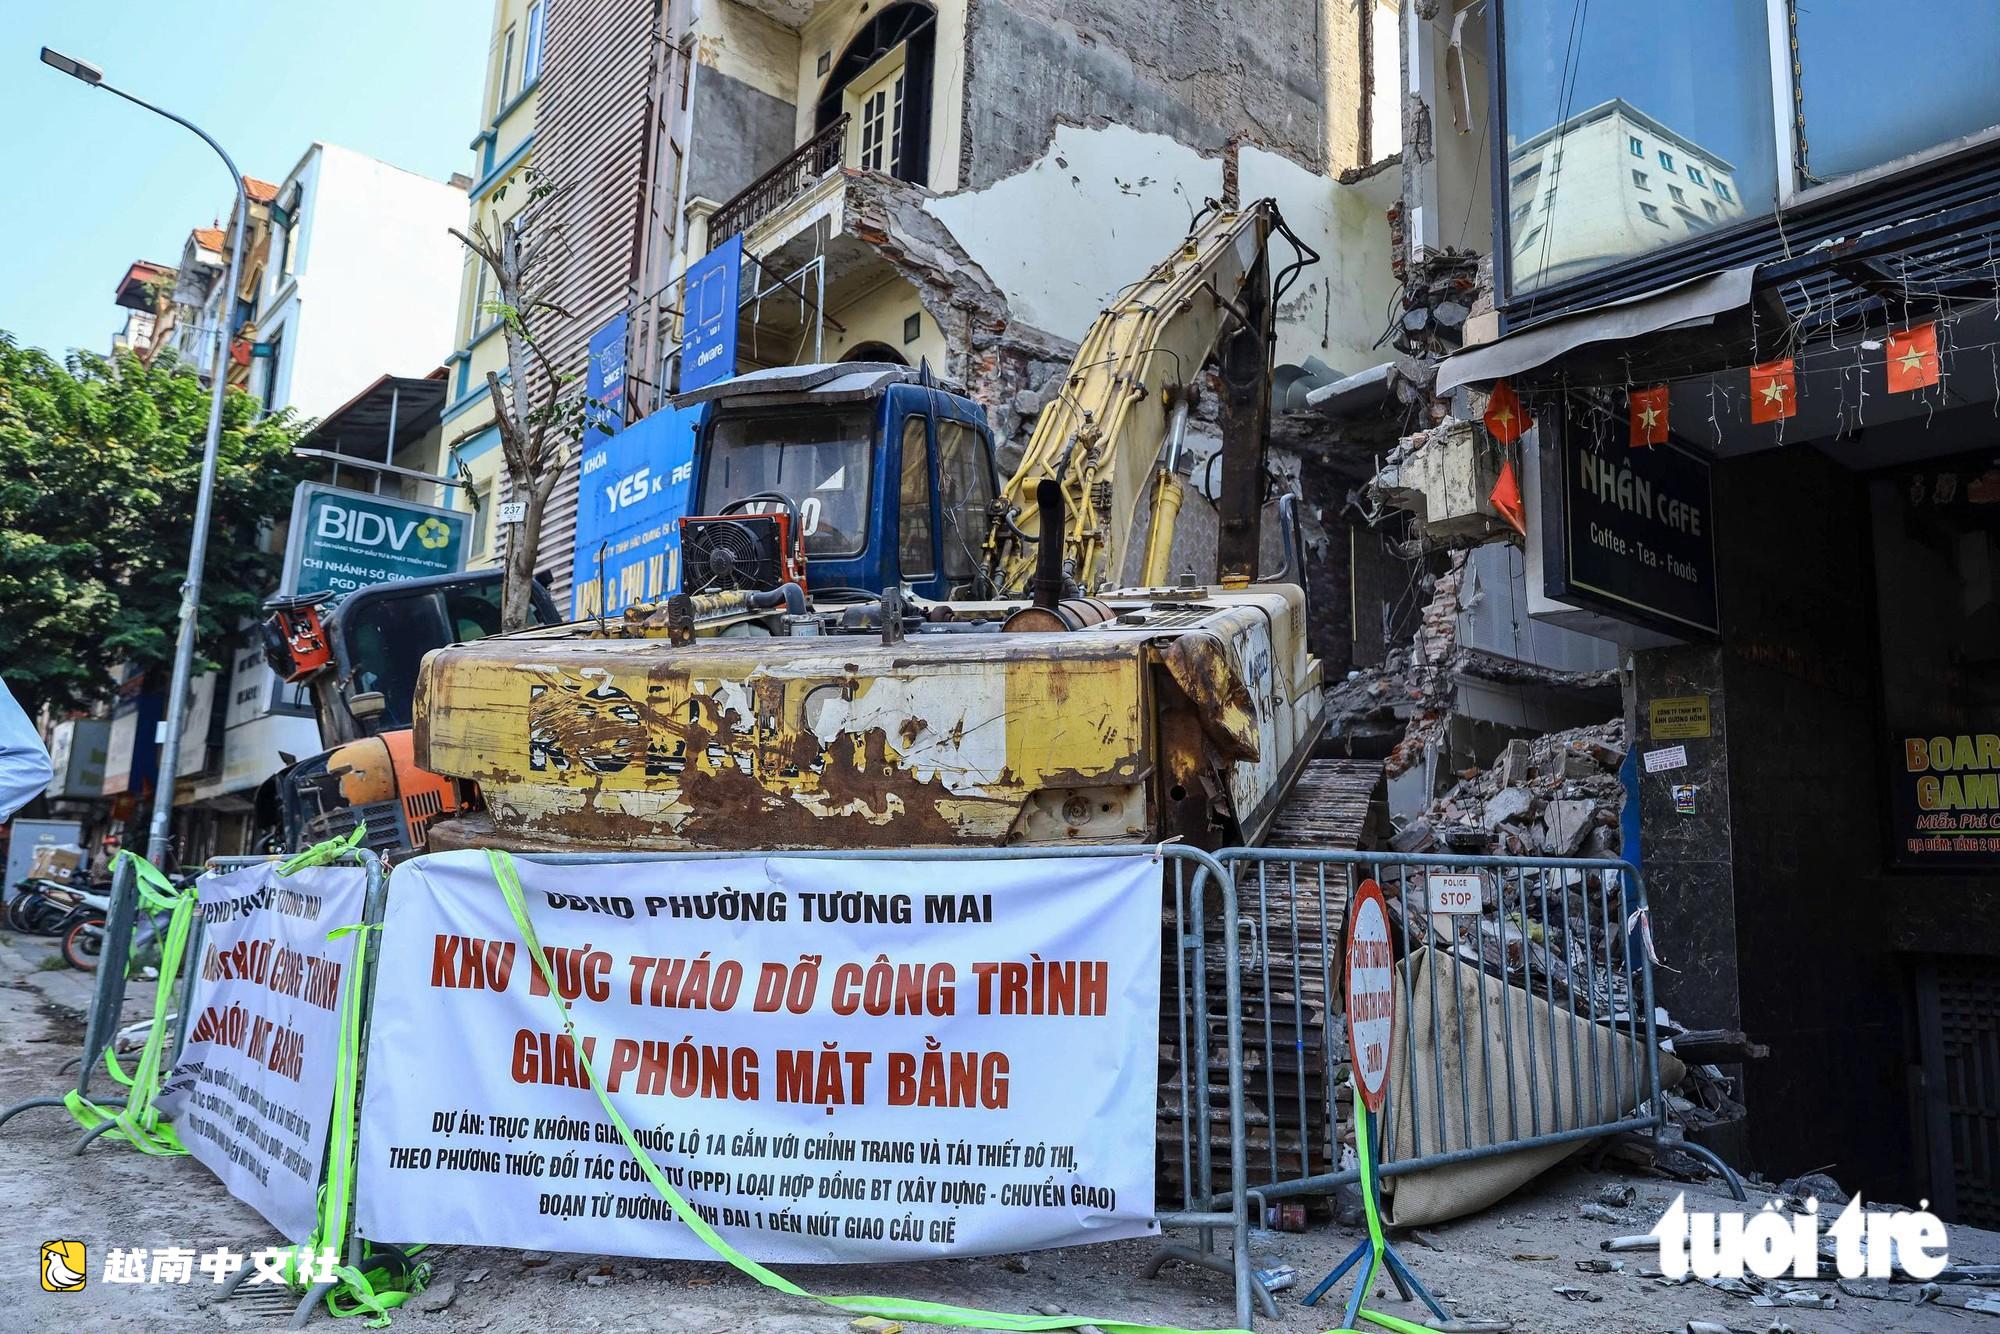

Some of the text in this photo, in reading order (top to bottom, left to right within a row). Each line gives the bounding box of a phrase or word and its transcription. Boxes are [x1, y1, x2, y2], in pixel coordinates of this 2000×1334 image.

[584, 452, 607, 475] KHÓA
[504, 506, 521, 515] 237
[606, 468, 651, 513] YES
[1580, 450, 1701, 537] NHÂN CAFE
[317, 504, 420, 550] BIDV
[303, 558, 323, 569] CHI
[325, 559, 367, 577] NHÁNH
[369, 568, 386, 580] SỞ
[1590, 521, 1626, 556] Coffee
[1637, 541, 1657, 568] Tea
[1667, 553, 1698, 583] Foods
[329, 577, 357, 591] PGD
[1917, 773, 2000, 811] GAM
[1917, 812, 1957, 830] Miễn
[1959, 813, 1987, 830] Phí
[1440, 892, 1473, 907] STOP
[1444, 879, 1467, 887] POLICE
[545, 886, 993, 924] UBND PHƯỜNG TƯƠNG MAI
[431, 934, 516, 993] KHU
[629, 951, 744, 1012] THÁO
[753, 953, 822, 1015] DỠ
[831, 953, 957, 1017] CÔNG
[971, 952, 1109, 1017] TRÌNH
[606, 1036, 760, 1102] PHÓNG
[776, 1040, 872, 1115] MẶT
[887, 1035, 1010, 1110] BẰNG
[432, 1110, 457, 1138] DỰ
[459, 1109, 484, 1136] ÁN:
[489, 1115, 529, 1143] TRỤC
[533, 1115, 590, 1142] KHÔNG
[678, 1128, 700, 1161] LỘ
[706, 1134, 726, 1156] 1A
[731, 1127, 768, 1157] GẮN
[772, 1132, 799, 1159] VỚI
[804, 1132, 856, 1162] CHỈNH
[861, 1140, 915, 1164] TRANG
[920, 1137, 941, 1165] VÀ
[946, 1138, 971, 1166] TÁI
[976, 1138, 1021, 1167] THIẾT
[1024, 1142, 1045, 1168] ĐÔ
[1050, 1145, 1078, 1173] THỊ,
[389, 1147, 431, 1169] THEO
[436, 1147, 500, 1173] PHƯƠNG
[505, 1150, 545, 1177] THỨC
[549, 1146, 579, 1179] ĐỐI
[584, 1152, 614, 1180] TÁC
[664, 1165, 685, 1187] TƯ
[688, 1169, 731, 1195] (PPP)
[736, 1173, 775, 1201] LOẠI
[779, 1173, 814, 1202] HỢP
[818, 1169, 866, 1201] ĐỒNG
[870, 1178, 892, 1201] BT
[897, 1175, 936, 1204] (XÂY
[941, 1180, 986, 1209] DỰNG
[1001, 1175, 1065, 1207] CHUYỂN
[1070, 1183, 1116, 1212] GIAO)
[539, 1193, 587, 1221] ĐOẠN
[591, 1191, 615, 1217] TỪ
[616, 1192, 672, 1222] ĐƯỜNG
[723, 1208, 750, 1228] ĐAI
[755, 1211, 763, 1229] 1
[769, 1206, 801, 1233] ĐẾN
[807, 1208, 840, 1237] NÚT
[844, 1217, 884, 1240] GIAO
[889, 1211, 924, 1242] CẦU
[929, 1216, 957, 1244] GIẼ
